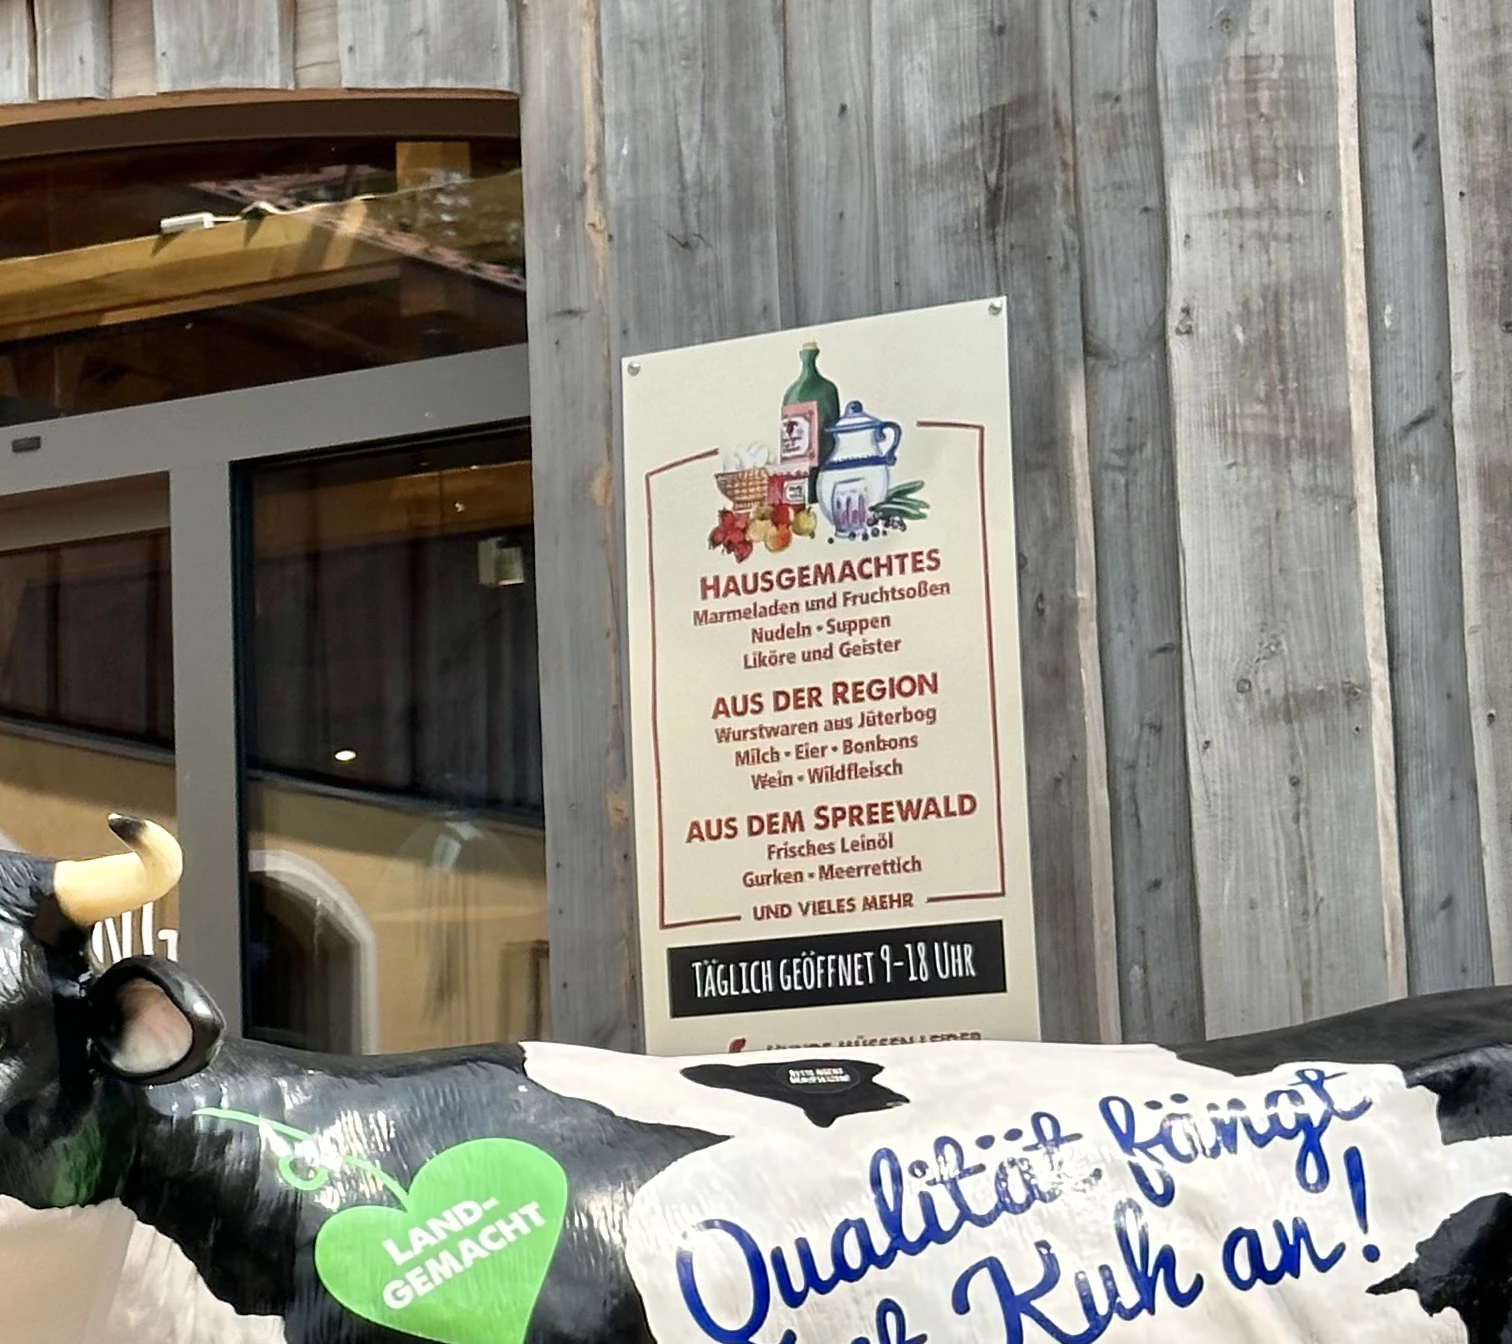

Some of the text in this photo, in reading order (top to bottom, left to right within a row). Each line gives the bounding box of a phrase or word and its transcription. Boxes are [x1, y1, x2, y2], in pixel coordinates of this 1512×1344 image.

[700, 548, 942, 600] HAUSGEMACHTES
[693, 581, 951, 626] Marmeladen und Fruchtsoßen
[751, 613, 892, 644] Nudeln Suppen
[743, 636, 902, 670] Liköre und Geister
[711, 672, 939, 720] AUS DER REGION
[714, 705, 937, 744] Wurstwaren aus Jüterbog
[734, 732, 919, 767] Milch Eier Bonbons
[751, 759, 903, 790] Wein Wildfleisch
[685, 793, 978, 844] AUS DEM SPREEWALD
[767, 833, 894, 861] Frisches Leinöl
[742, 856, 922, 889] Gurken Meerrettich
[752, 892, 914, 921] UND VIELES MEHR
[691, 940, 977, 999] TÄGLICH GEÖFFNET 9-18 UHR
[1099, 1068, 1372, 1207] fängt
[382, 1197, 499, 1266] LAND-
[1221, 1146, 1381, 1292] an!
[382, 1201, 546, 1310] GEMACHT
